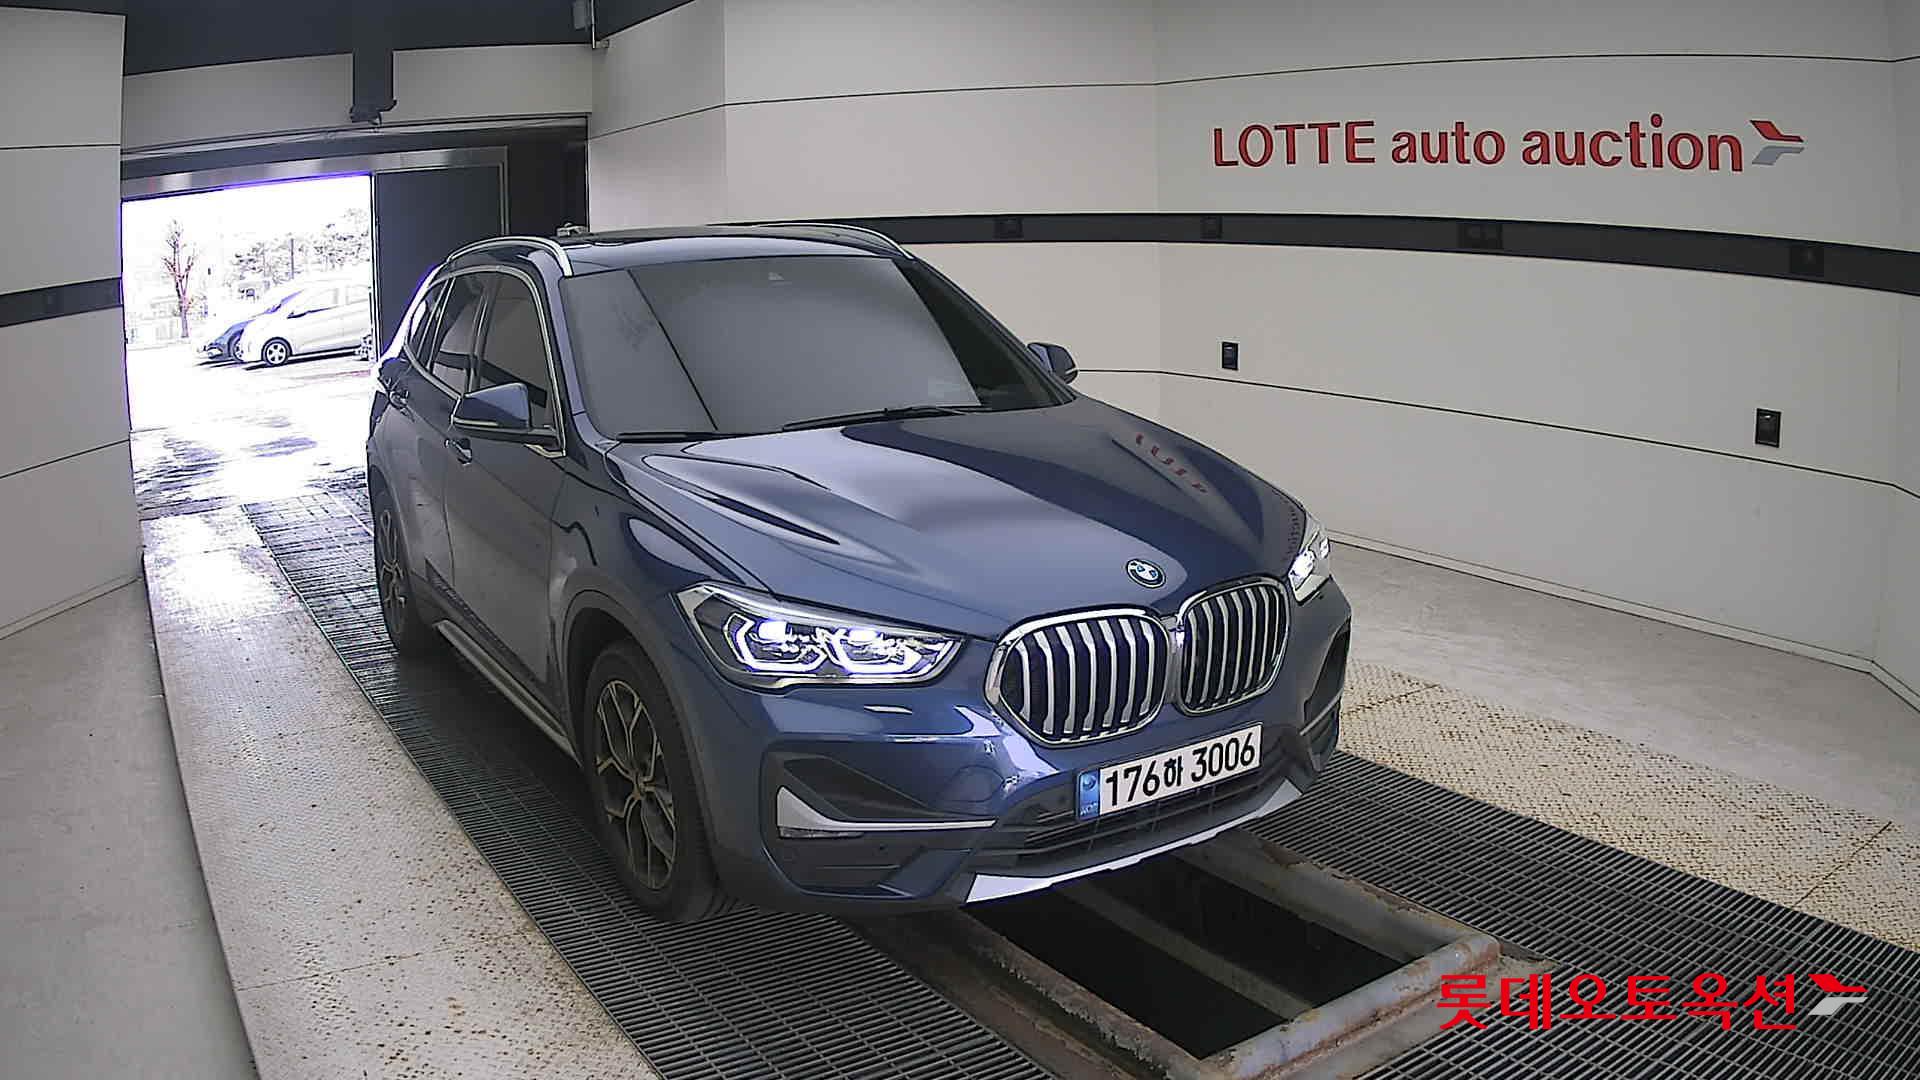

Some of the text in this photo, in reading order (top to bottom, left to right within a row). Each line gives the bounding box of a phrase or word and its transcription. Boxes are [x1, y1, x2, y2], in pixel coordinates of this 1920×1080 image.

[1213, 113, 1743, 172] LOTTE auto auction
[1106, 732, 1255, 807] 176하 3006
